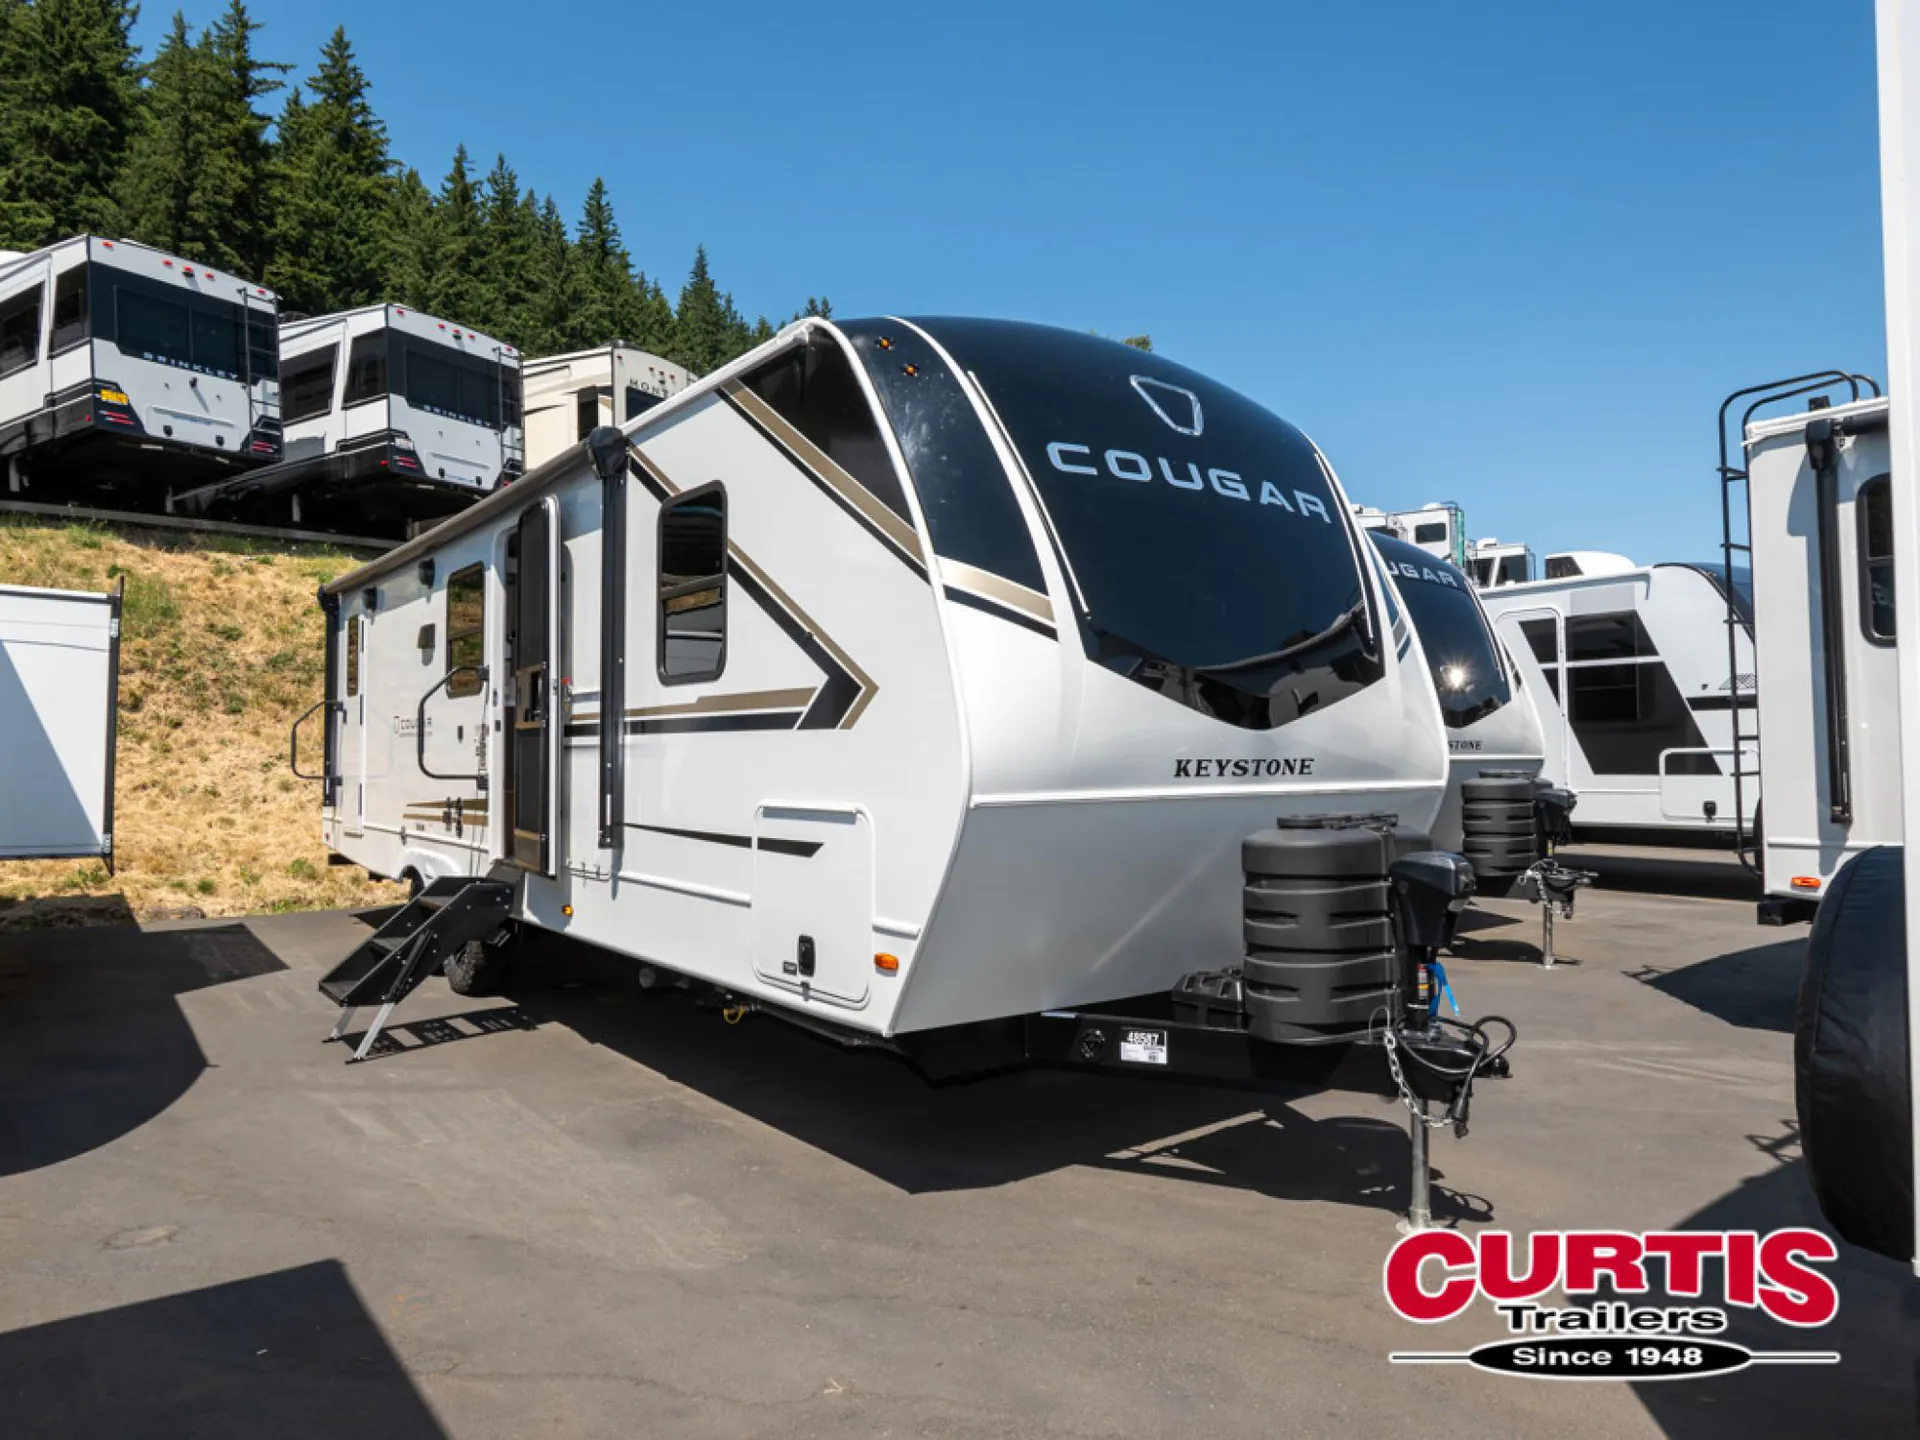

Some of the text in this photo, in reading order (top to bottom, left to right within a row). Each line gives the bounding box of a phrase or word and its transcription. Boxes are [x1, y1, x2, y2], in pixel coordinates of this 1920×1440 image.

[143, 351, 239, 380] BRINKLEY
[423, 404, 491, 427] BRINKLEY
[1045, 441, 1333, 524] COUGAR
[1174, 758, 1315, 778] KEYSTONE
